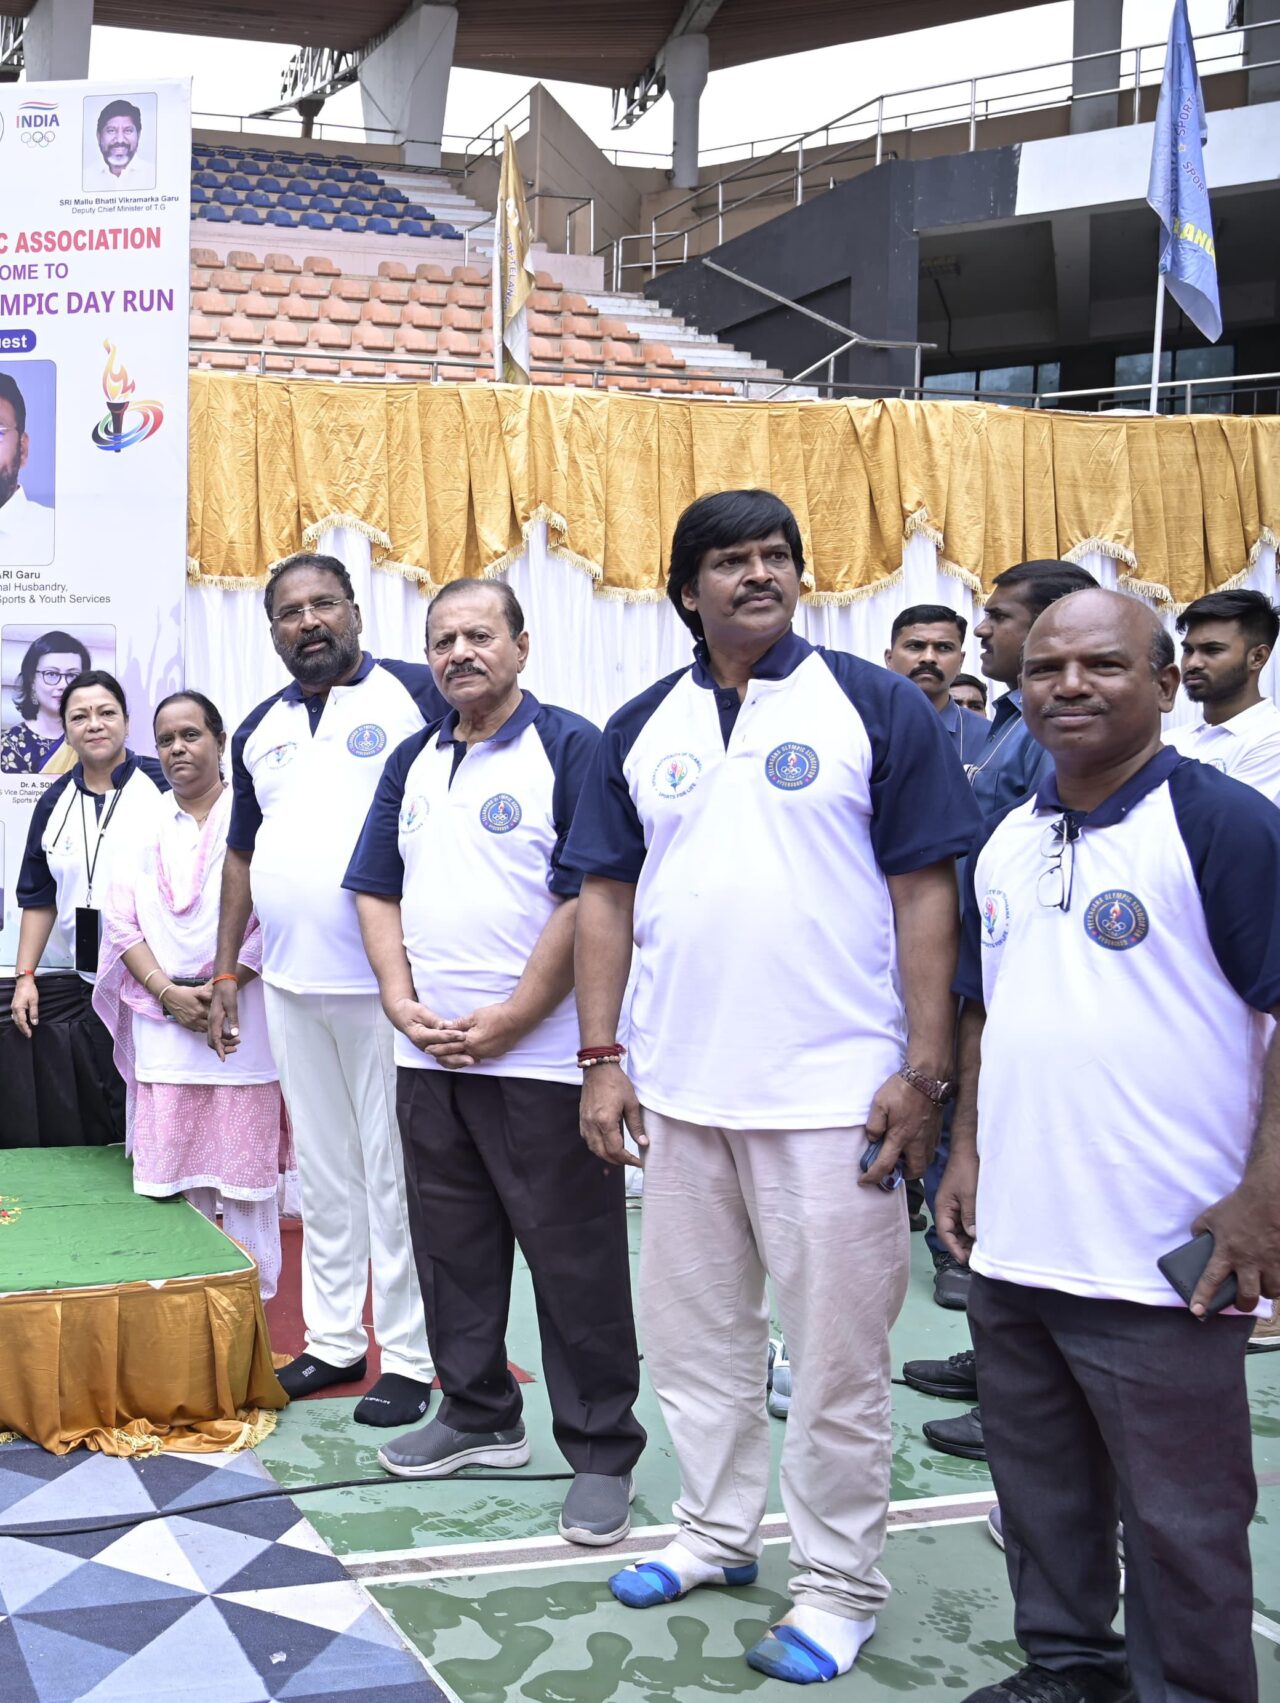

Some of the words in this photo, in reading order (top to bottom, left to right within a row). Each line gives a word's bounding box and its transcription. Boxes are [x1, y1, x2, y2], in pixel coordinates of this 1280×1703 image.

[16, 113, 60, 128] INDIA
[74, 198, 93, 206] Mallu
[95, 197, 117, 205] Bhatti
[118, 196, 159, 204] Vikramarka
[72, 207, 95, 215] Deputy
[117, 205, 144, 213] Minister
[15, 226, 162, 254] ASSOCIATION
[43, 262, 69, 280] TO
[503, 260, 516, 310] TELANG
[67, 290, 116, 314] DAY
[122, 288, 174, 313] RUN
[15, 570, 41, 580] Garu
[14, 581, 68, 593] Husbandry,
[28, 594, 36, 604] &
[38, 594, 66, 604] Youth
[69, 594, 111, 604] Services
[12, 796, 32, 804] Sports
